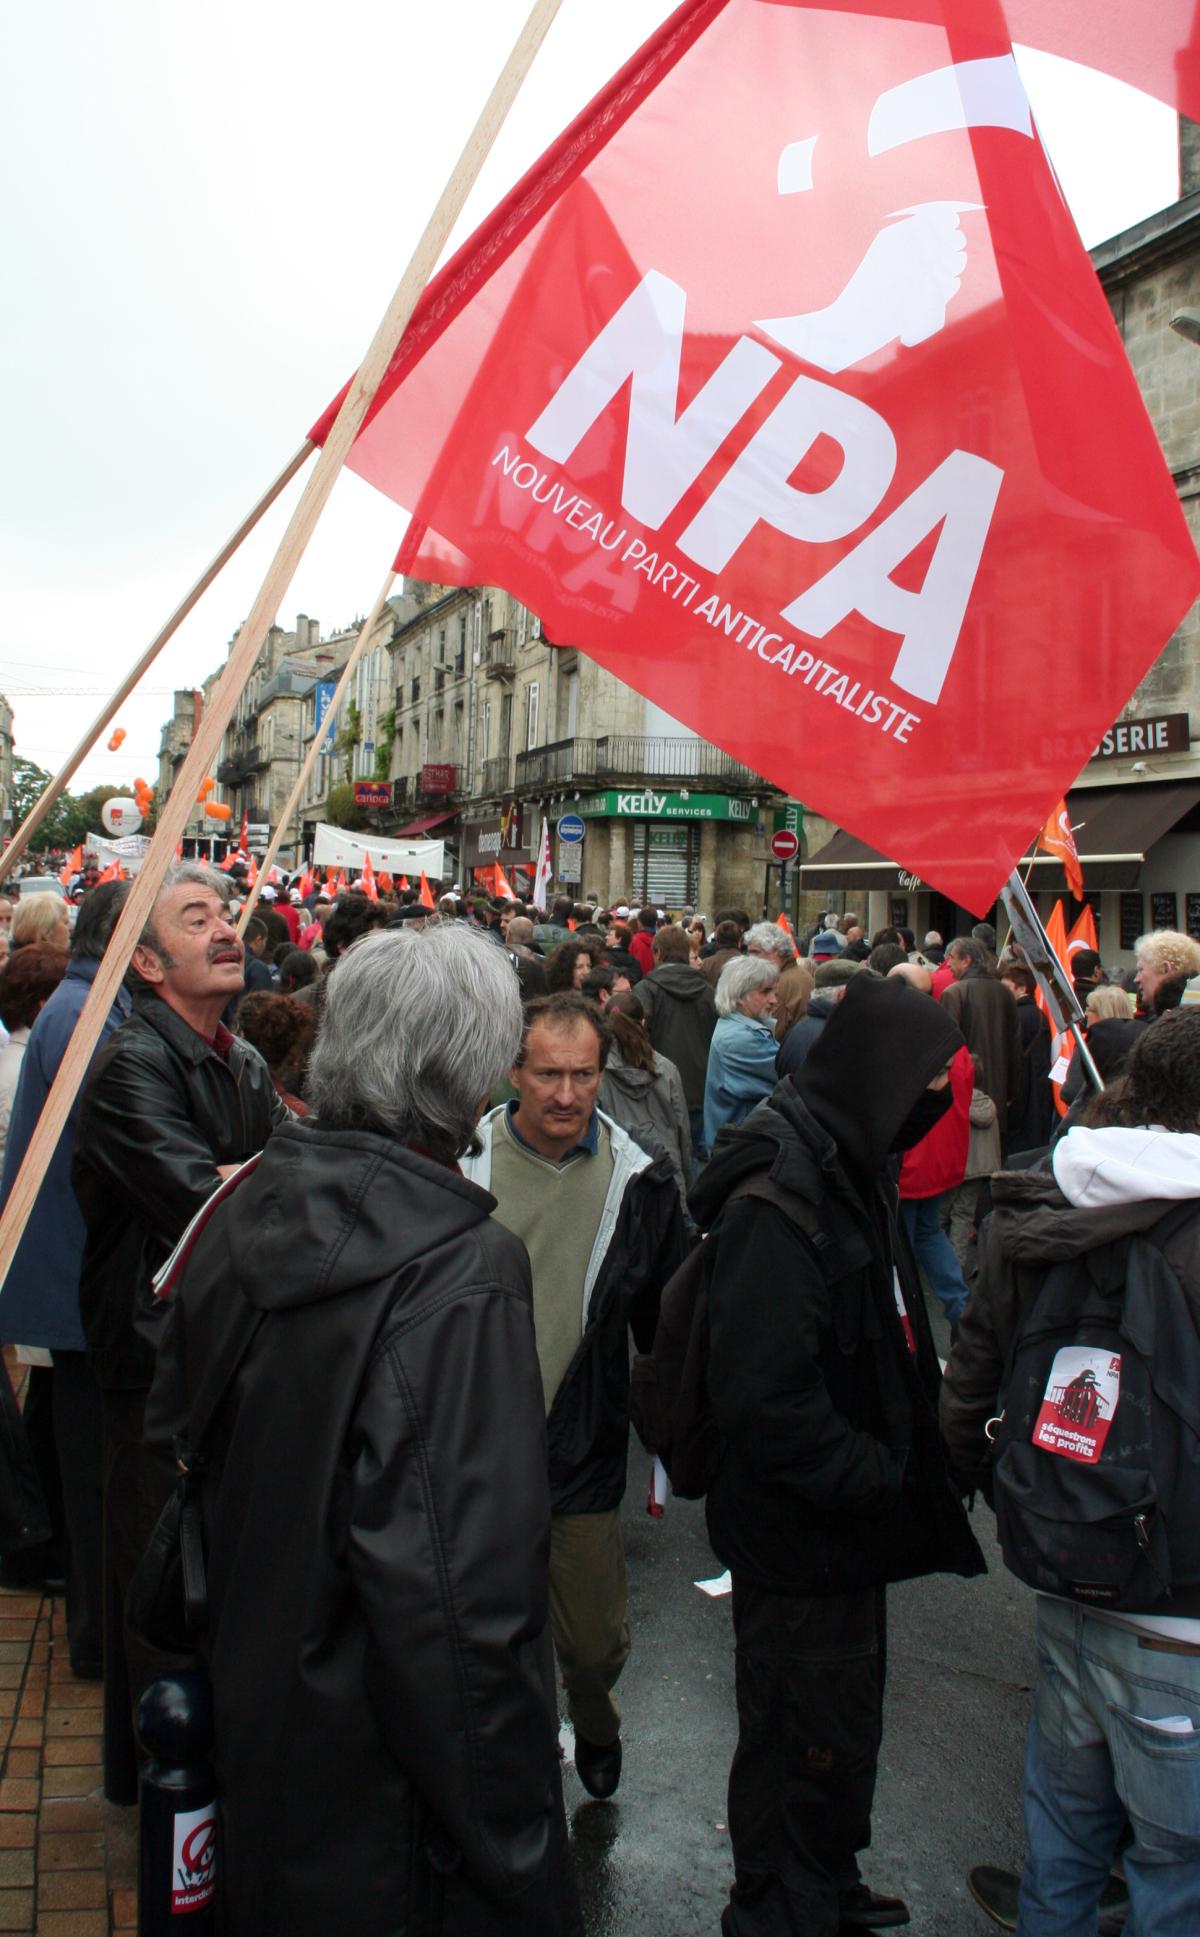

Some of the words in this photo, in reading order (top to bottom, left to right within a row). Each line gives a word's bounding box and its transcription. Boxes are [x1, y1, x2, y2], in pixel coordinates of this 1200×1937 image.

[524, 268, 1005, 705] NPA
[492, 445, 627, 550] NOUVEAU
[622, 538, 702, 607] PARTI
[693, 594, 921, 744] ANTICAPITALISTE
[617, 794, 667, 814] KELLY
[666, 807, 712, 816] SERVICES
[728, 799, 751, 819] KELLY
[785, 806, 798, 835] ELLY
[1038, 1430, 1056, 1444] les
[1057, 1438, 1094, 1457] profits
[1041, 1422, 1097, 1447] séquestrons
